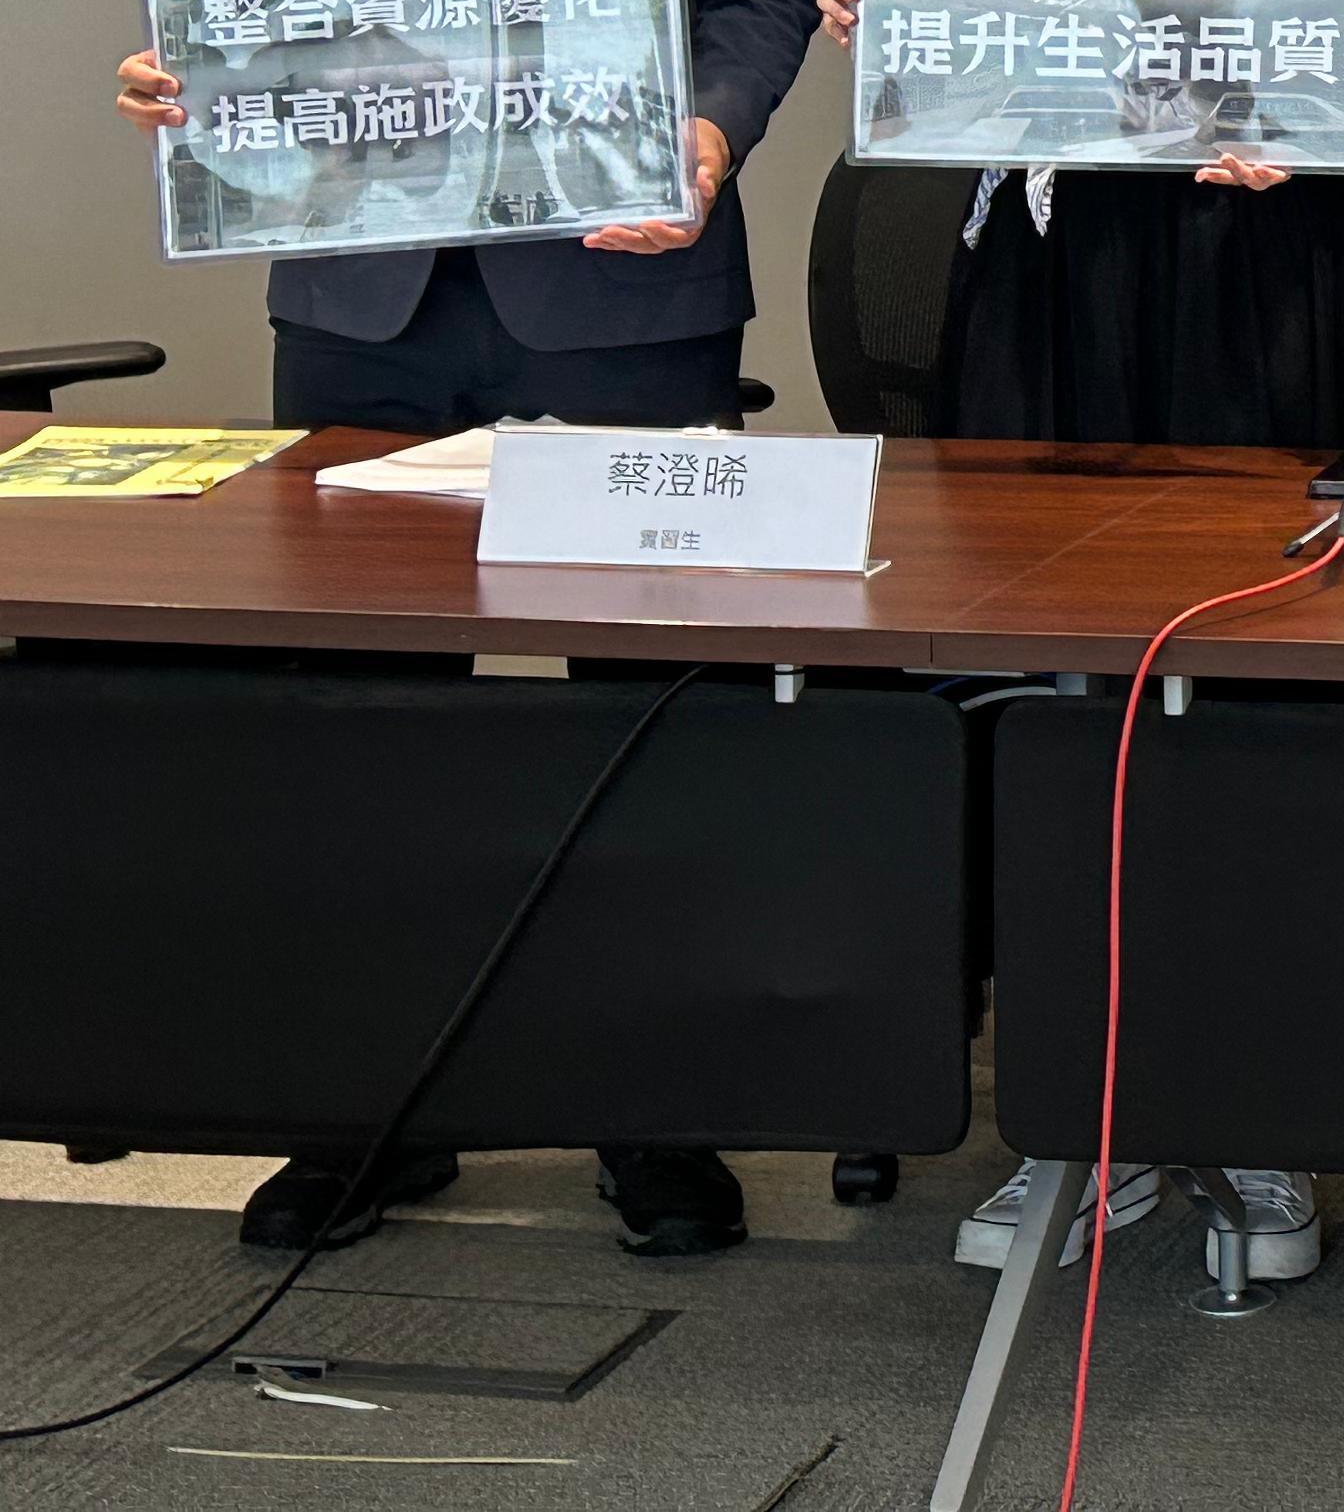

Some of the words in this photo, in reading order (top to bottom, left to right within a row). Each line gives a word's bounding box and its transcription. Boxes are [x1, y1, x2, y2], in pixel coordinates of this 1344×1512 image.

[882, 9, 1341, 84] 提升生活品質
[211, 66, 632, 153] 提高施政成效
[608, 452, 747, 499] 蔡澄晞
